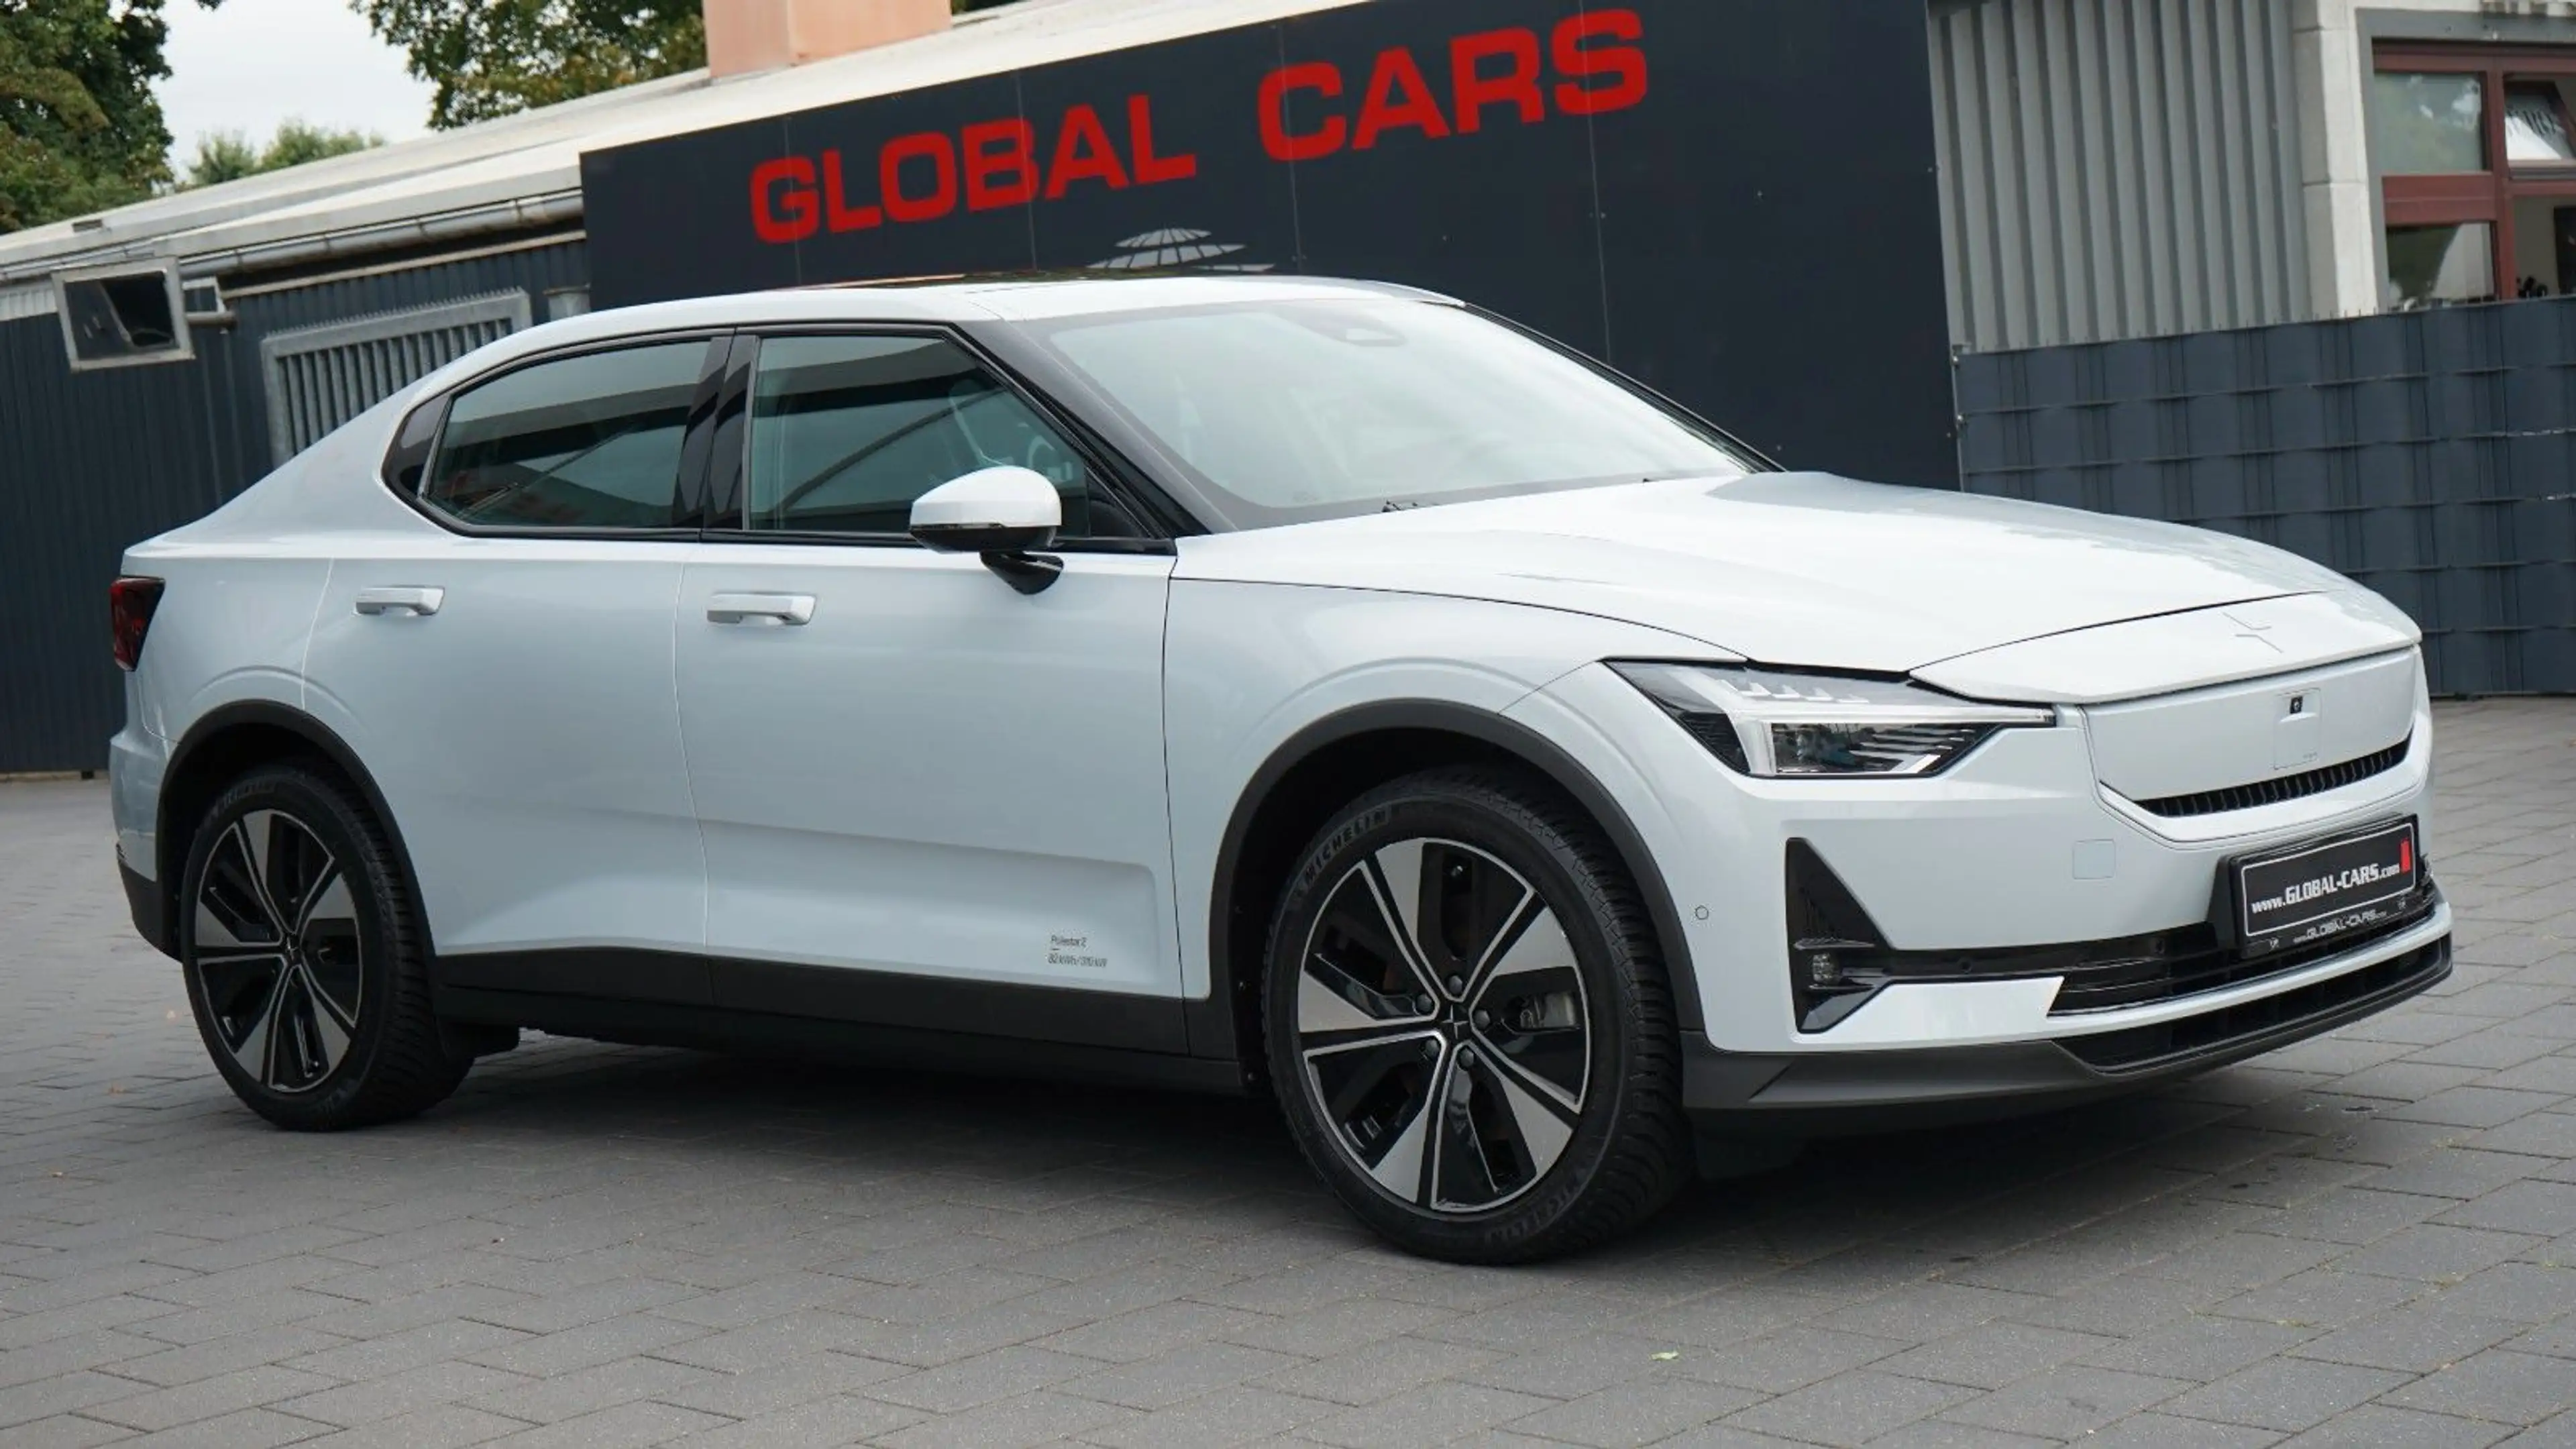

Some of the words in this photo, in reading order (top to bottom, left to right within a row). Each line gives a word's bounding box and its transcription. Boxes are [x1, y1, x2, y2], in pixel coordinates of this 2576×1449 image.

[751, 95, 1196, 242] GLOBAL
[1258, 9, 1647, 161] CARS
[1305, 808, 1387, 883] MICHELIN
[2251, 863, 2400, 914] www.GLOBAL-CARS.com
